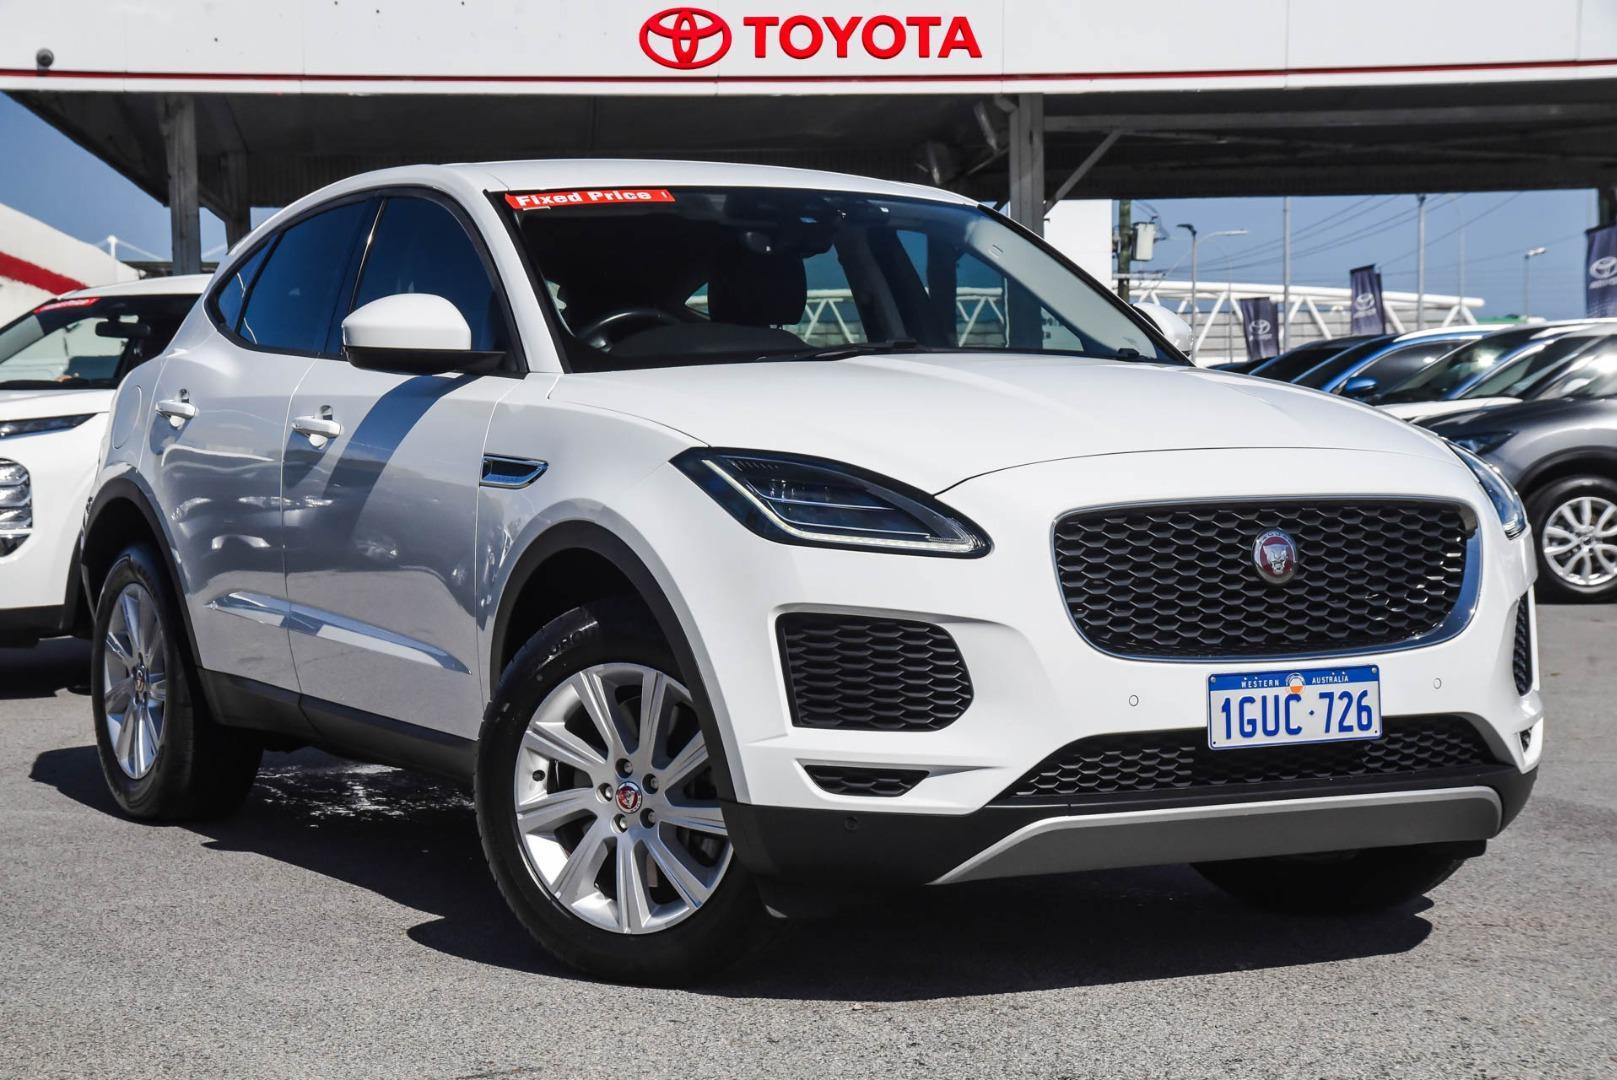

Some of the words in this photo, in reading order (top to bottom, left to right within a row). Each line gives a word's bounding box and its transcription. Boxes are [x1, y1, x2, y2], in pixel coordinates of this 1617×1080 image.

[743, 15, 982, 59] TOYOTA
[515, 192, 583, 207] Fixed
[588, 191, 652, 201] Price
[1241, 679, 1280, 688] WESTERN
[1311, 675, 1349, 684] AUSTRALIA
